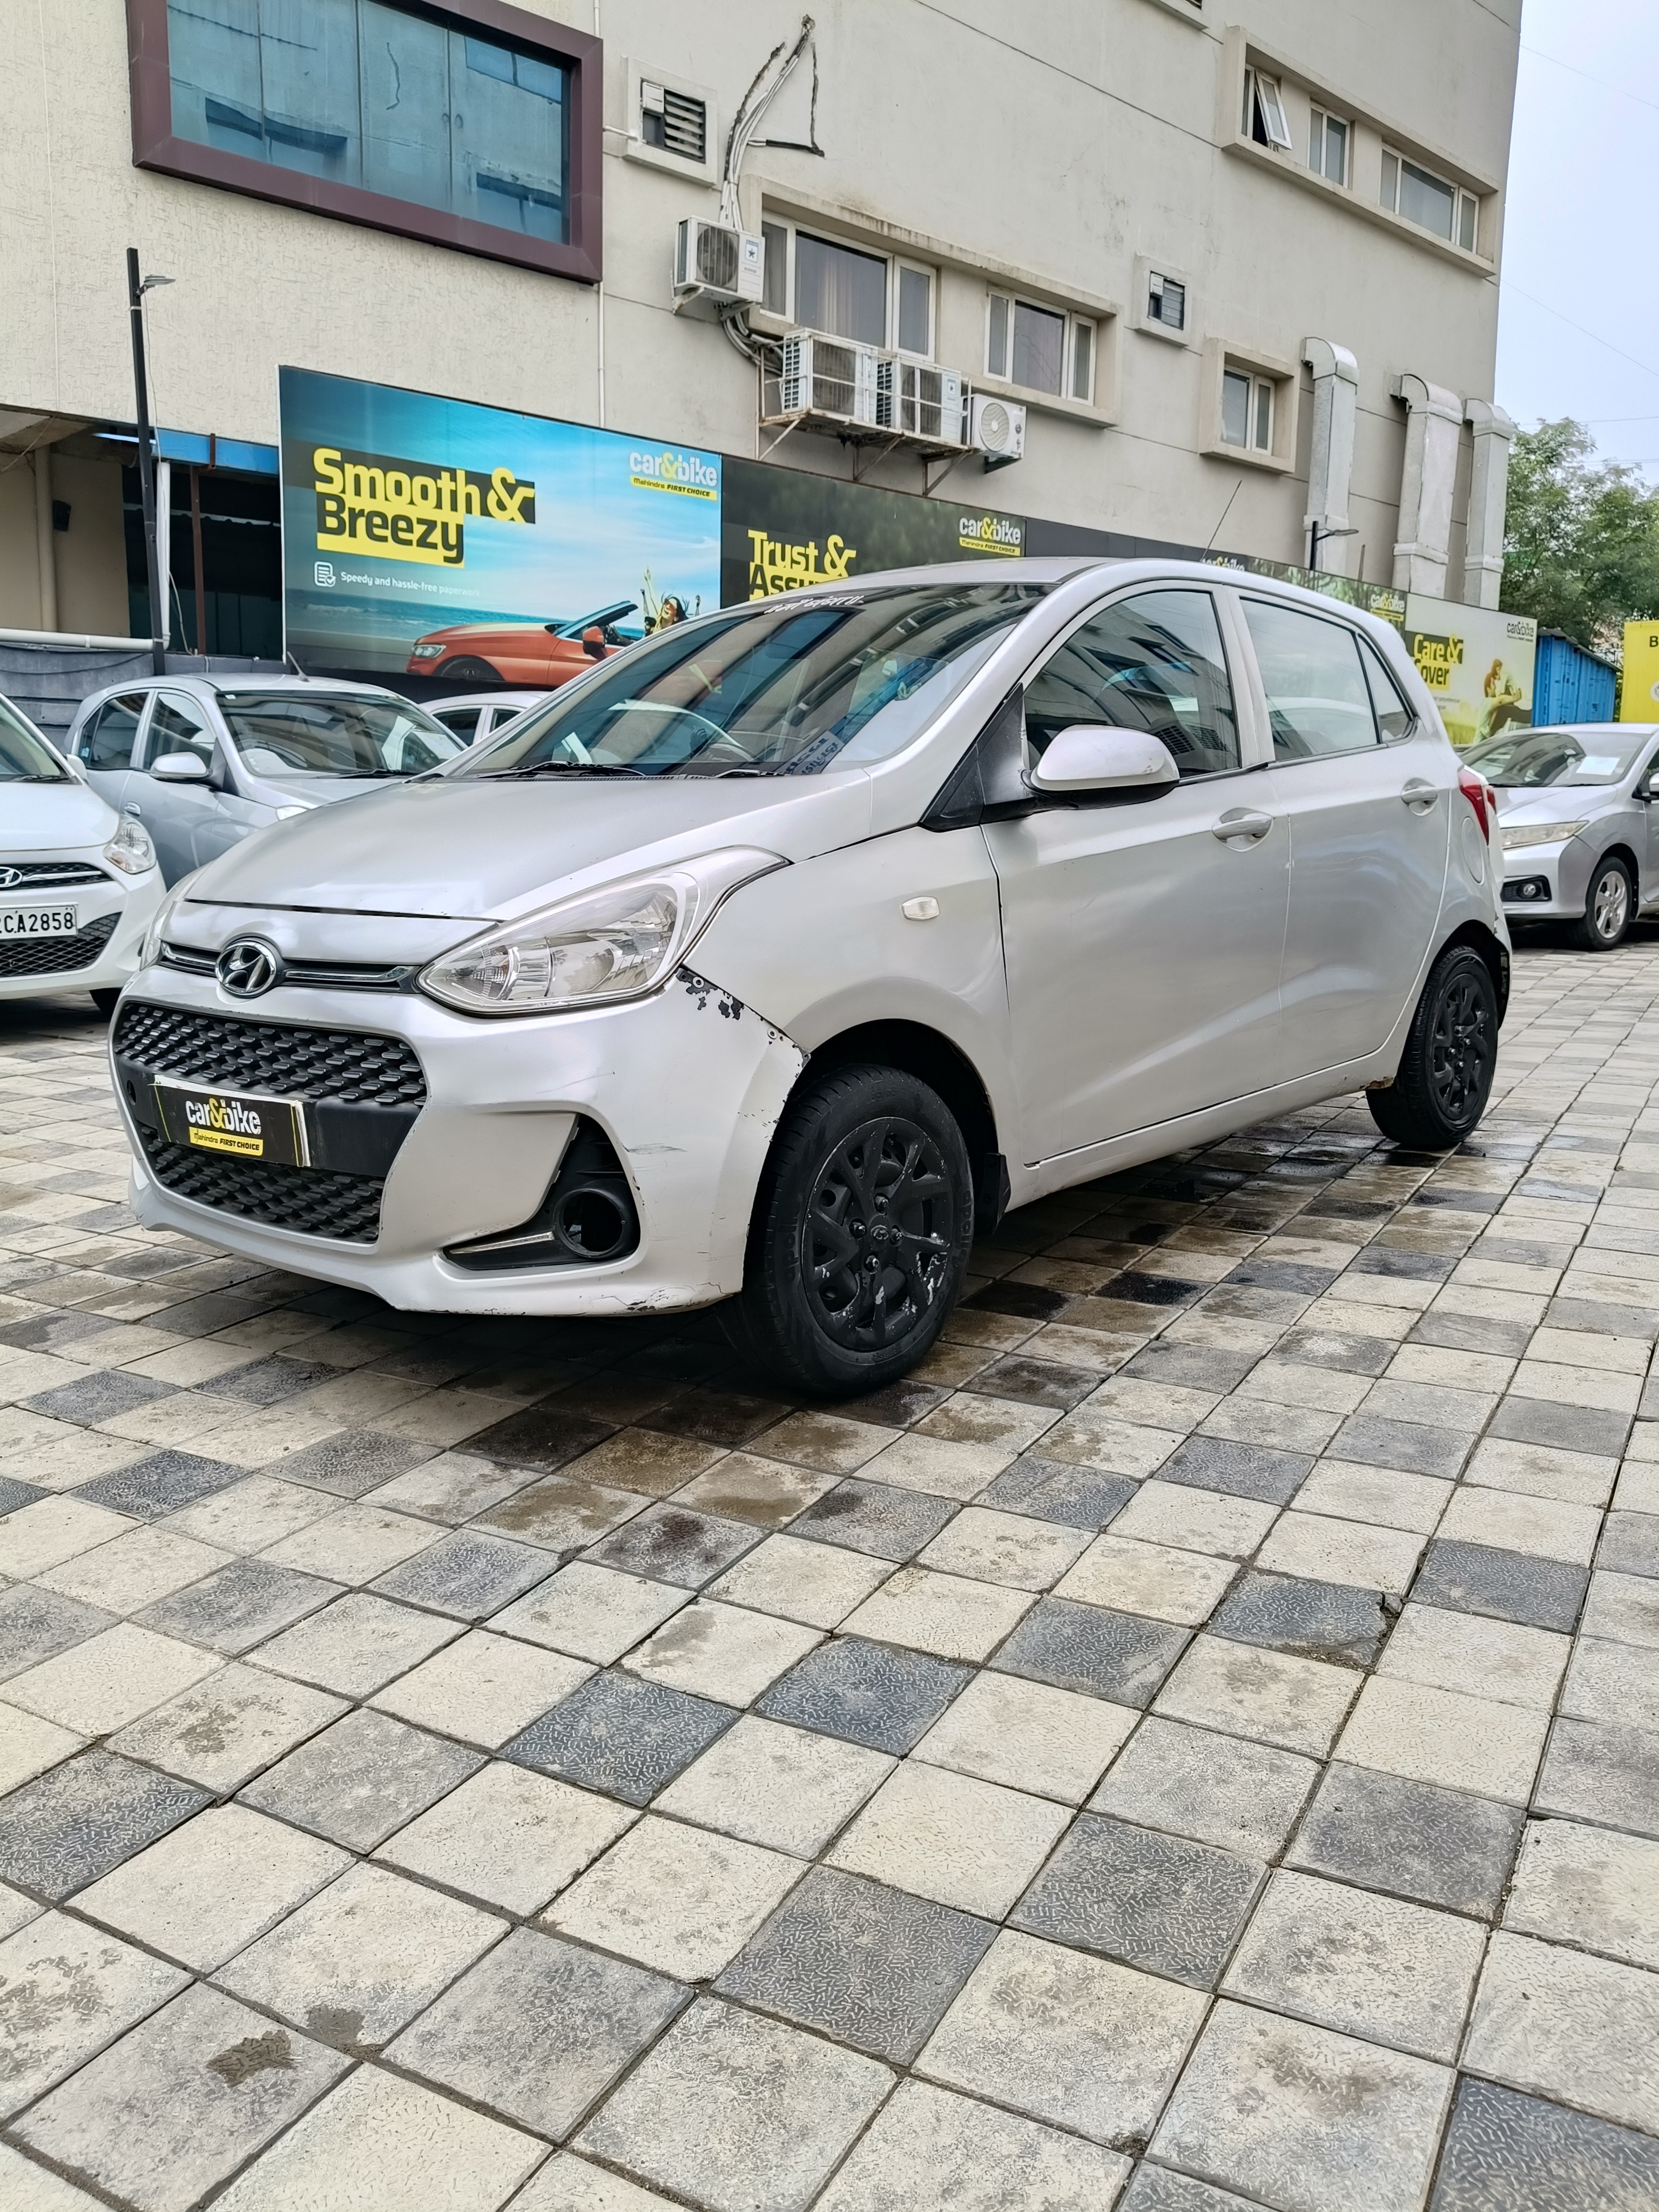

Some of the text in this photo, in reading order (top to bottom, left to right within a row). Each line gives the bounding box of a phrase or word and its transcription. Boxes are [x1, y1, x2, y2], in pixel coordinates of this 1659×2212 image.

[629, 451, 717, 487] car&bike
[313, 448, 535, 523] Smooth &
[667, 484, 686, 493] FIRST
[687, 488, 710, 497] CHOICE
[317, 492, 464, 563] Breezy
[959, 517, 1021, 544] car&bike
[748, 529, 857, 577] Trust &
[341, 571, 481, 597] Speedy and hassle-free paperwork
[1507, 622, 1534, 637] car&bike
[1414, 633, 1463, 664] Care &
[0, 912, 73, 933] CA2858
[185, 1098, 261, 1135] car&bike
[220, 1138, 236, 1147] FIRST
[237, 1142, 259, 1150] CHOICE
